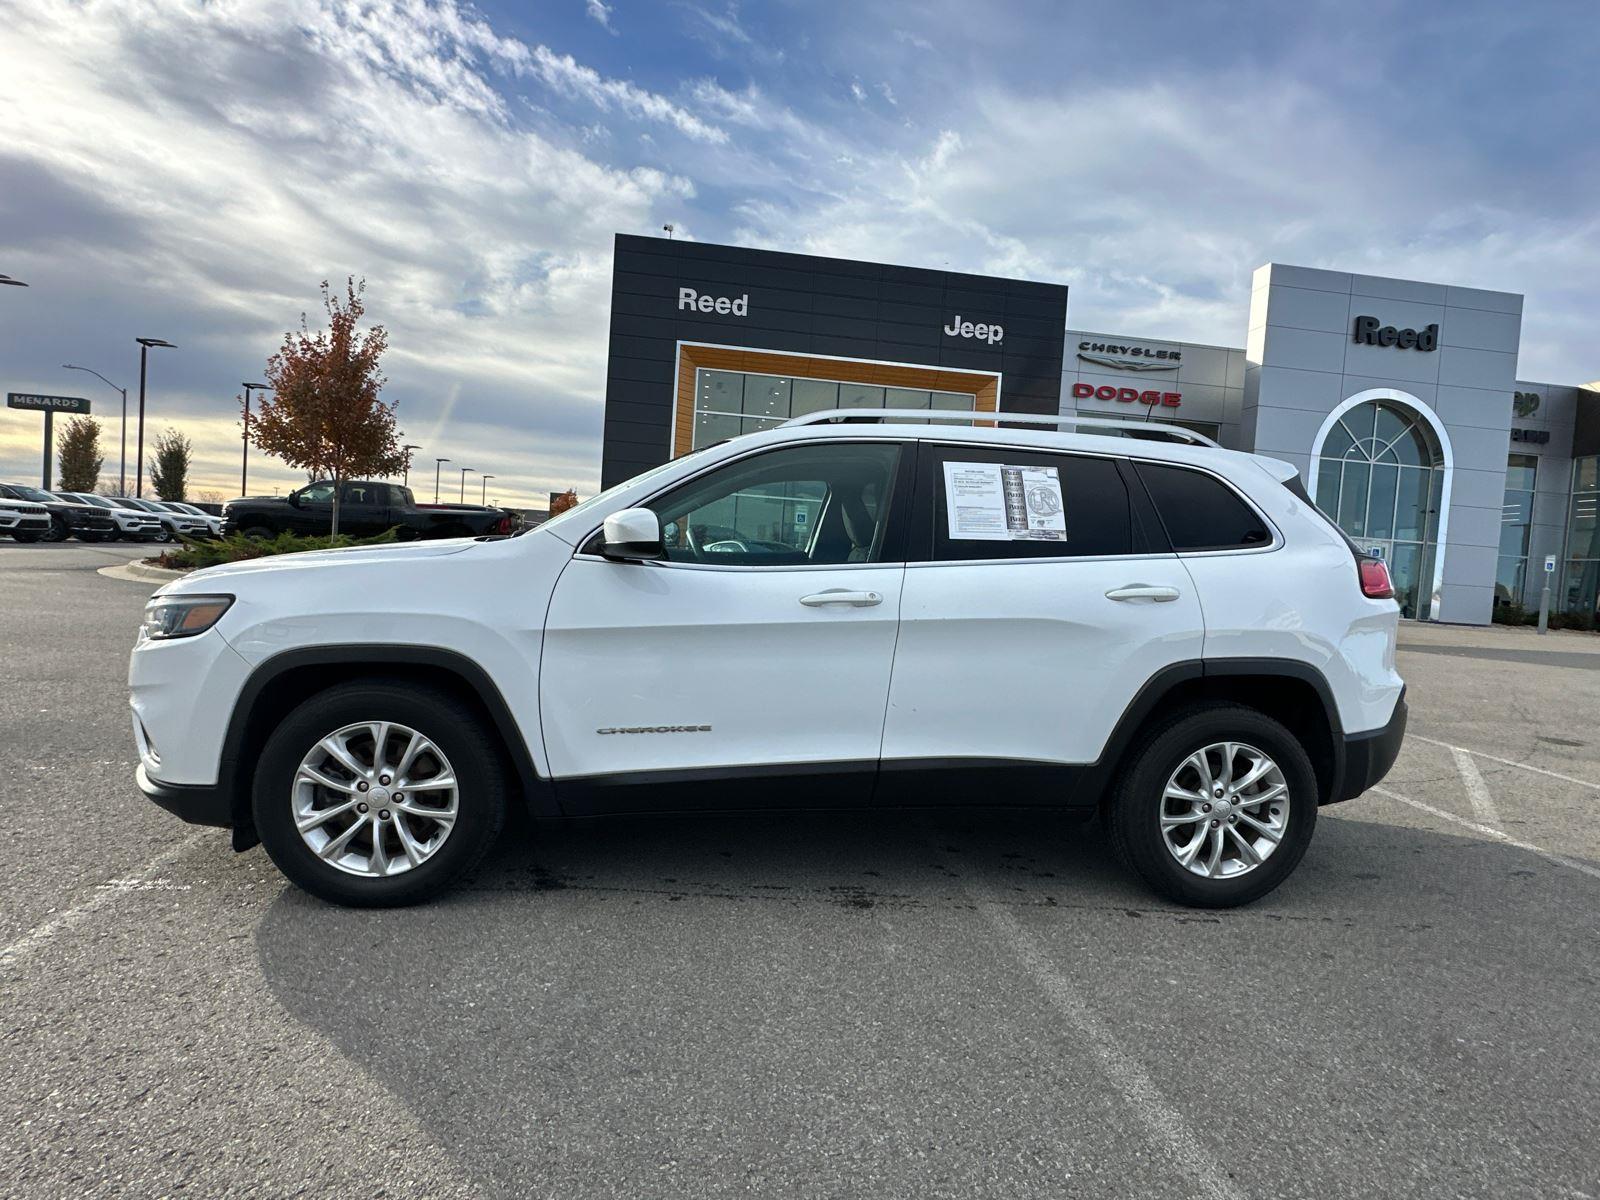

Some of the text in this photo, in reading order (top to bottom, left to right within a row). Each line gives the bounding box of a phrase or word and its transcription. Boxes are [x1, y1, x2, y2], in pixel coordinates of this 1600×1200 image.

[678, 287, 749, 317] Reed
[943, 315, 1004, 345] Jeep
[1353, 315, 1440, 352] Reed
[1078, 341, 1182, 361] CHRYSLER
[13, 395, 79, 408] MENARDS
[1073, 383, 1182, 408] DODGE
[596, 725, 712, 735] CHEROKEE
